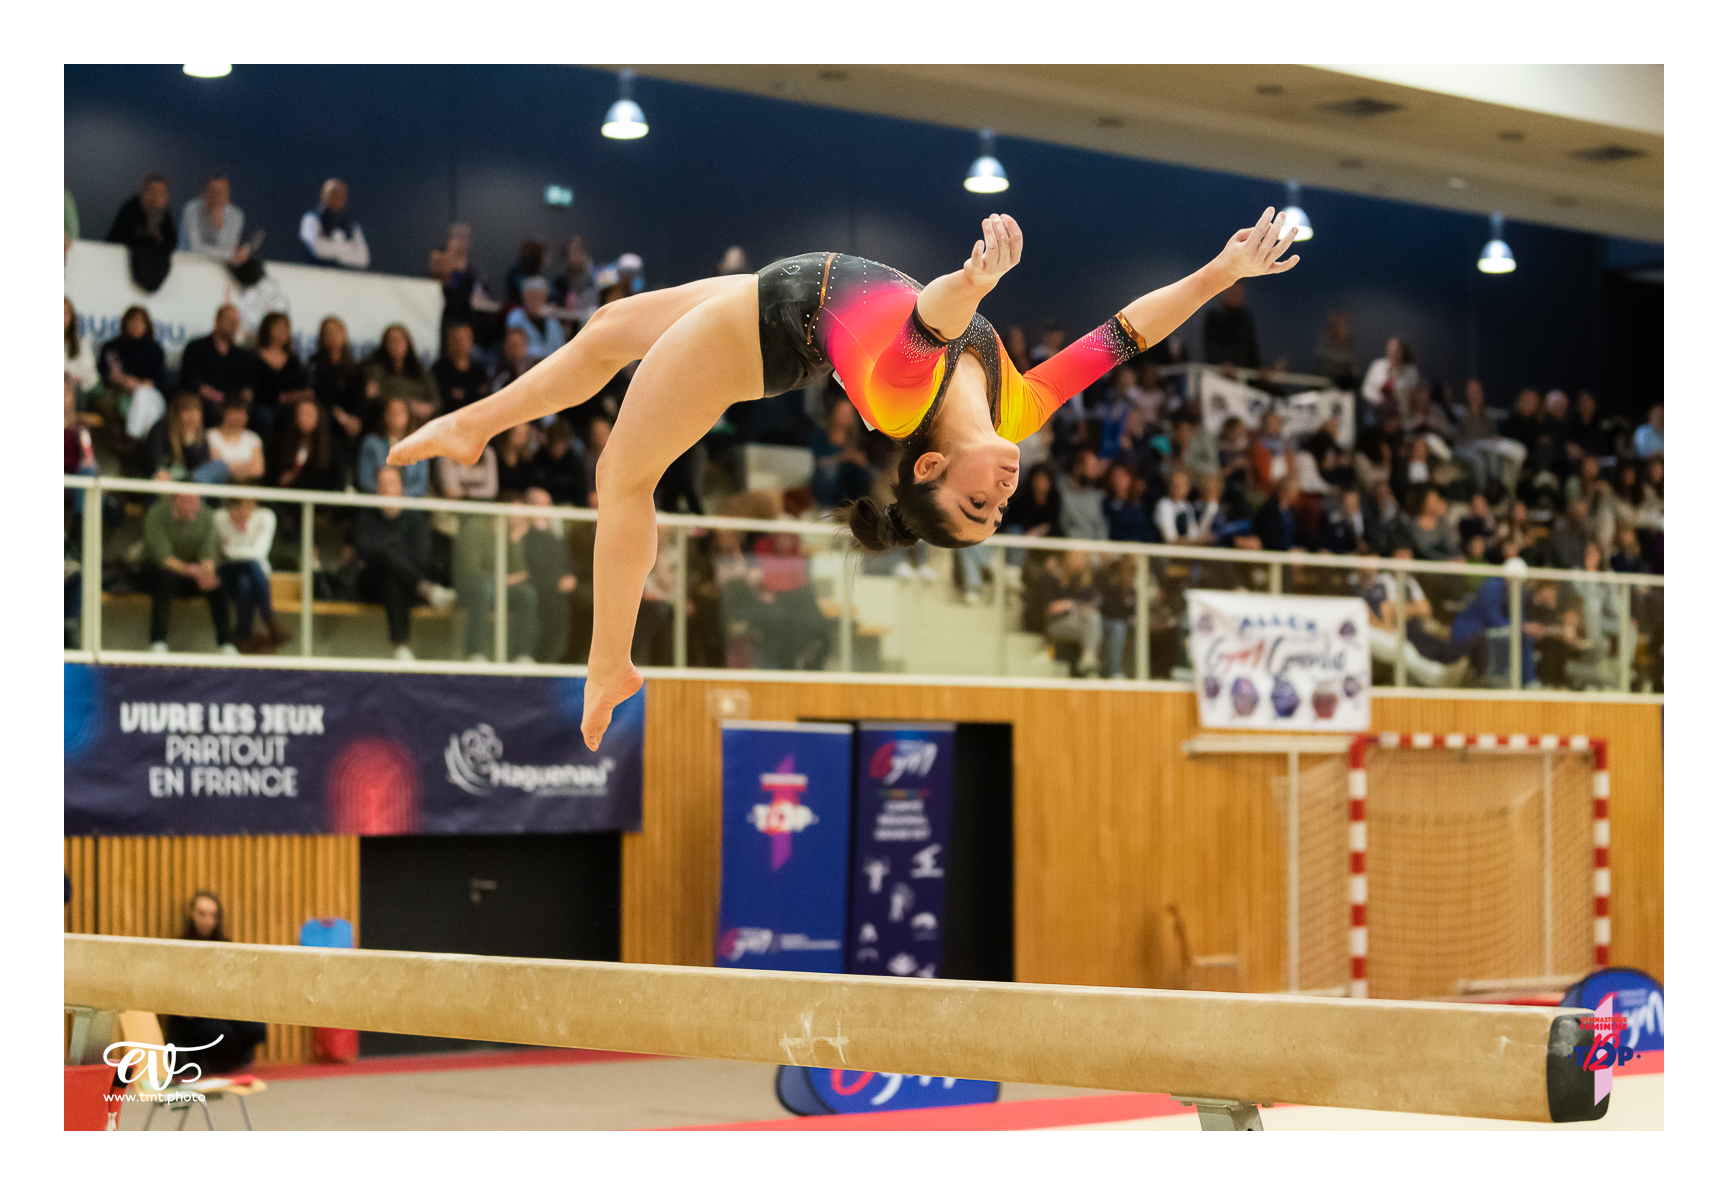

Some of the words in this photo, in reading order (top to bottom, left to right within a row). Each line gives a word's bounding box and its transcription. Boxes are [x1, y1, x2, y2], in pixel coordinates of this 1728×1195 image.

[120, 701, 204, 733] VIVRE
[208, 702, 256, 734] LES
[260, 703, 325, 735] JEUX
[165, 734, 289, 766] PARTOUT
[149, 766, 185, 797] EN
[190, 766, 298, 798] FRANCE
